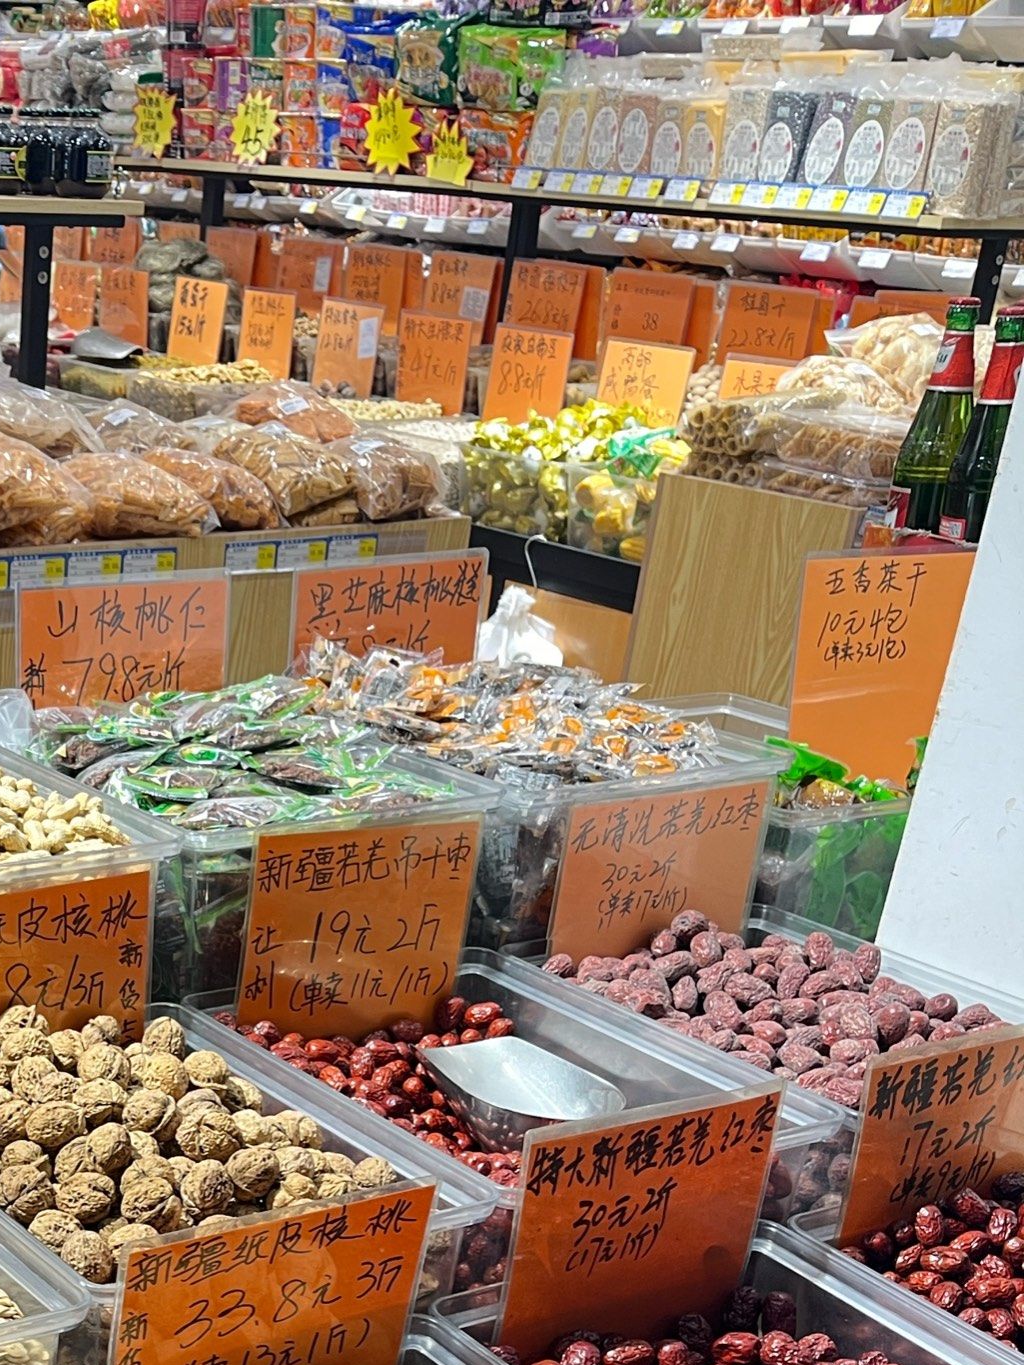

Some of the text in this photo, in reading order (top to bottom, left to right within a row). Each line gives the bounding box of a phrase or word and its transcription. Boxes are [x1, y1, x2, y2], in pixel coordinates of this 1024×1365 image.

[47, 586, 206, 645] 山核桃仁
[825, 560, 928, 607] 五香茶干
[118, 938, 144, 1044] 新货上
[526, 1095, 776, 1195] 特大新疆若羌红枣
[126, 1199, 417, 1292] 新疆纸皮核桃
